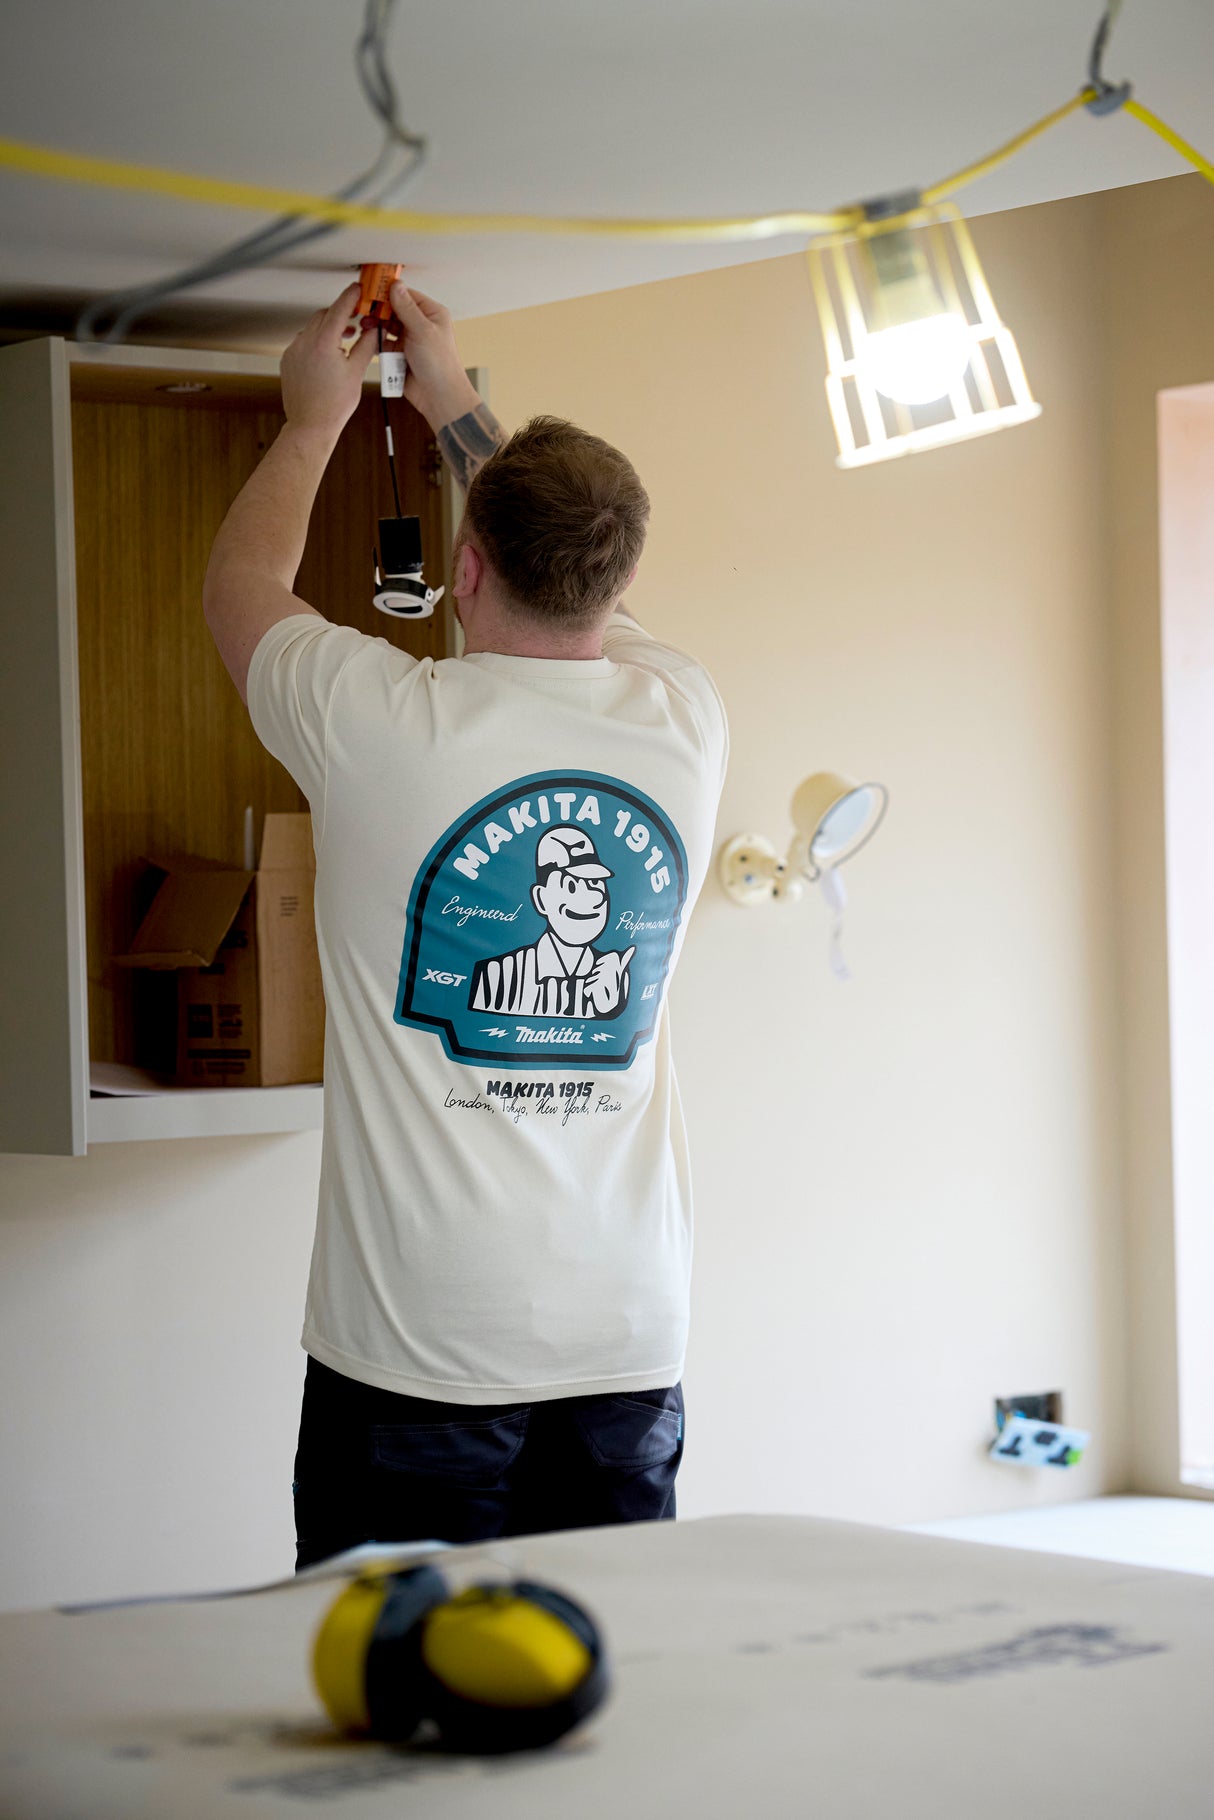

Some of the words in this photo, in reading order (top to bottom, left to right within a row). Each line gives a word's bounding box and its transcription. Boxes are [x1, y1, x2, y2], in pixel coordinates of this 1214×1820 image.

[453, 792, 601, 881] MAKITA
[613, 809, 671, 894] 1915
[422, 968, 468, 987] XGT
[486, 1080, 555, 1098] MAKITA
[559, 1081, 595, 1098] 1915
[444, 1088, 495, 1114] London,
[535, 1097, 558, 1115] New
[594, 1094, 622, 1114] Paris
